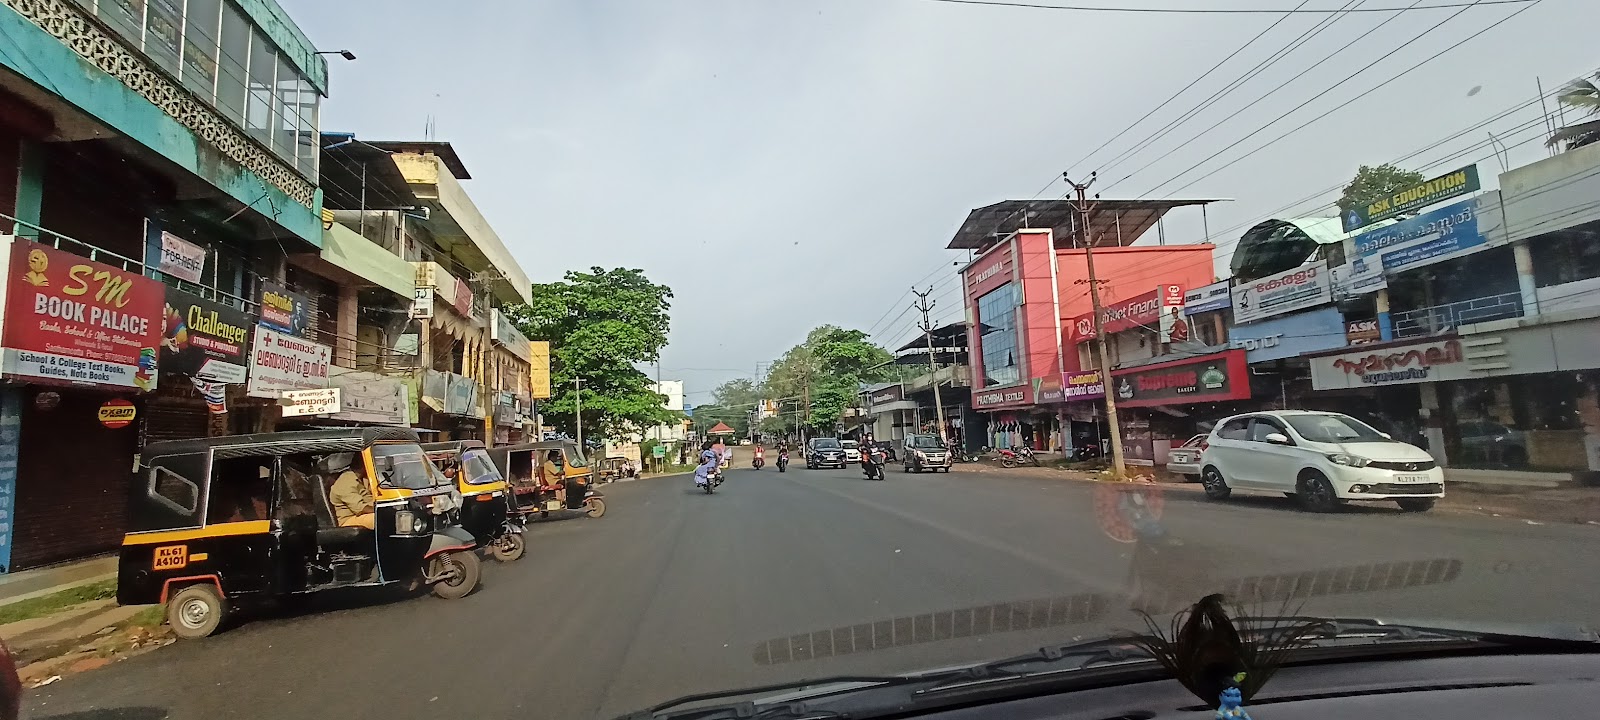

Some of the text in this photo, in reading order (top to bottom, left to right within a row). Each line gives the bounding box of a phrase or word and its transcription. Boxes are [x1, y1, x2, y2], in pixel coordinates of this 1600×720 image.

[1368, 171, 1467, 216] ASK EDUCATION
[1399, 199, 1423, 210] TRAINING
[1432, 184, 1467, 199] PLACEMENT
[165, 249, 180, 263] FOR
[62, 265, 133, 308] SM
[35, 293, 149, 336] BOOK PALACE
[1127, 297, 1159, 317] Financ
[187, 304, 247, 344] Challenger
[1349, 321, 1377, 333] ASK
[64, 324, 87, 337] School
[94, 331, 111, 344] Office
[192, 336, 210, 348] STUDIO
[210, 339, 214, 348] &
[20, 352, 126, 376] School & College Text Books,
[296, 357, 302, 375] &
[39, 365, 110, 381] Guides, Note Books
[292, 396, 335, 406] ബോറട്ടറി
[976, 391, 1024, 405] PRATHIBHA TEXTILES
[100, 408, 134, 418] exam
[155, 556, 184, 566] A4101
[160, 548, 182, 557] KL61
